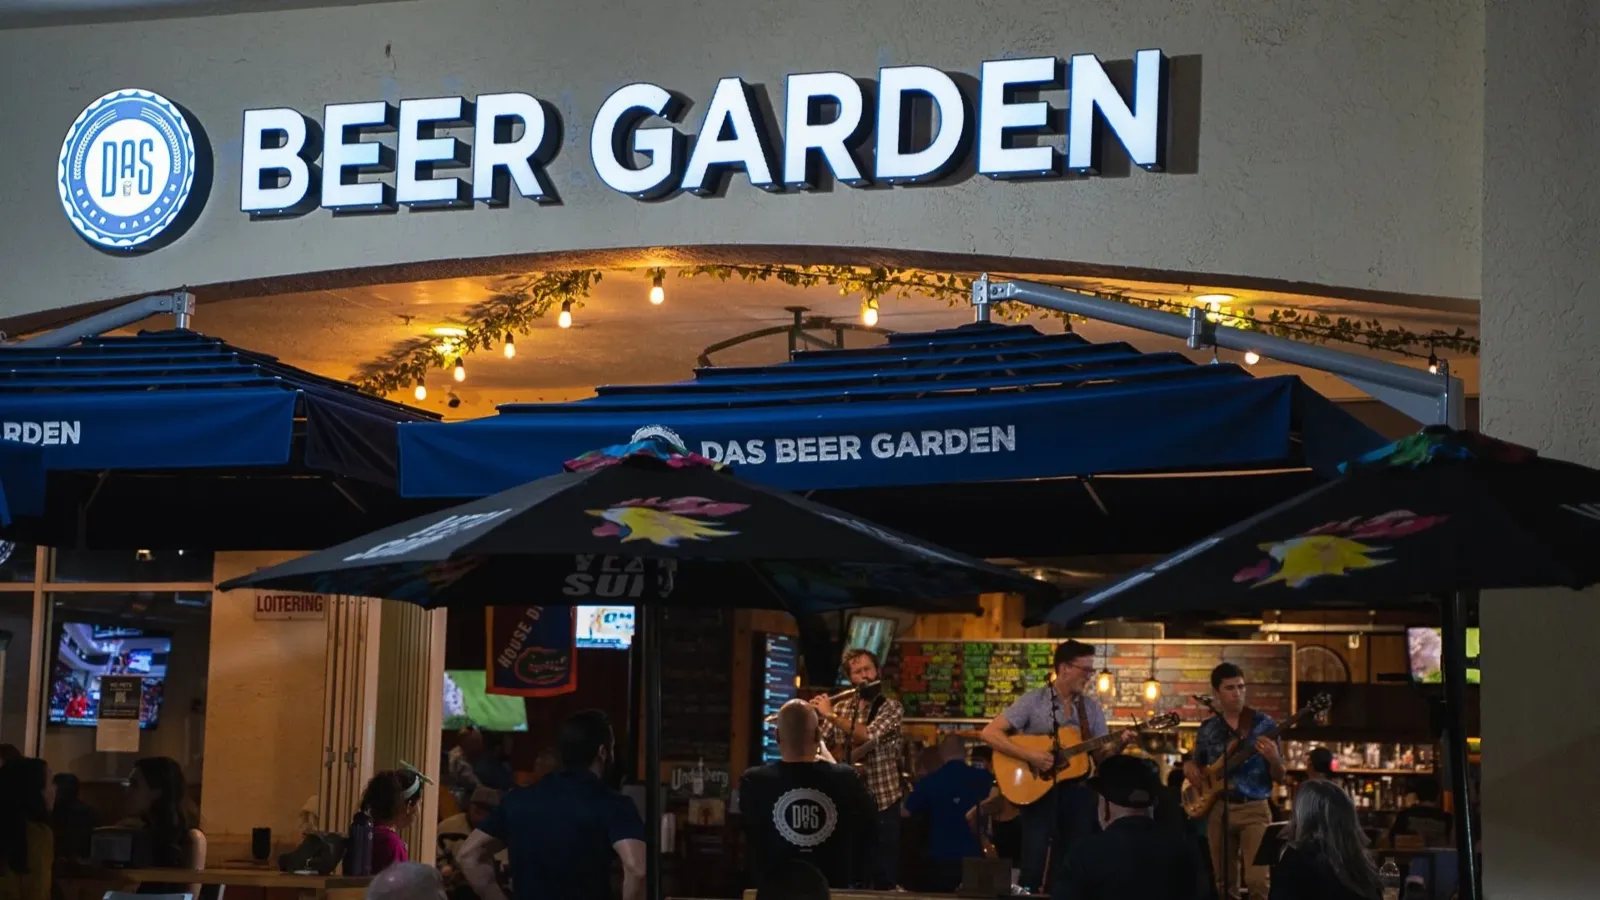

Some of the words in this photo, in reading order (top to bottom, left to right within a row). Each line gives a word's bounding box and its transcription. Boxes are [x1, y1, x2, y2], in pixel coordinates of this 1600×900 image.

[239, 91, 546, 213] BEER
[590, 48, 1164, 197] GARDEN
[101, 138, 154, 198] DAS
[76, 188, 108, 225] BEER
[119, 184, 177, 230] GARDEN
[0, 420, 81, 446] RDEN
[700, 439, 767, 465] DAS
[774, 435, 862, 464] BEER
[870, 424, 1016, 459] GARDEN
[256, 594, 324, 613] LOITERING
[497, 621, 533, 668] HOUSE
[671, 767, 729, 790] Undberg
[792, 804, 819, 829] DAS
